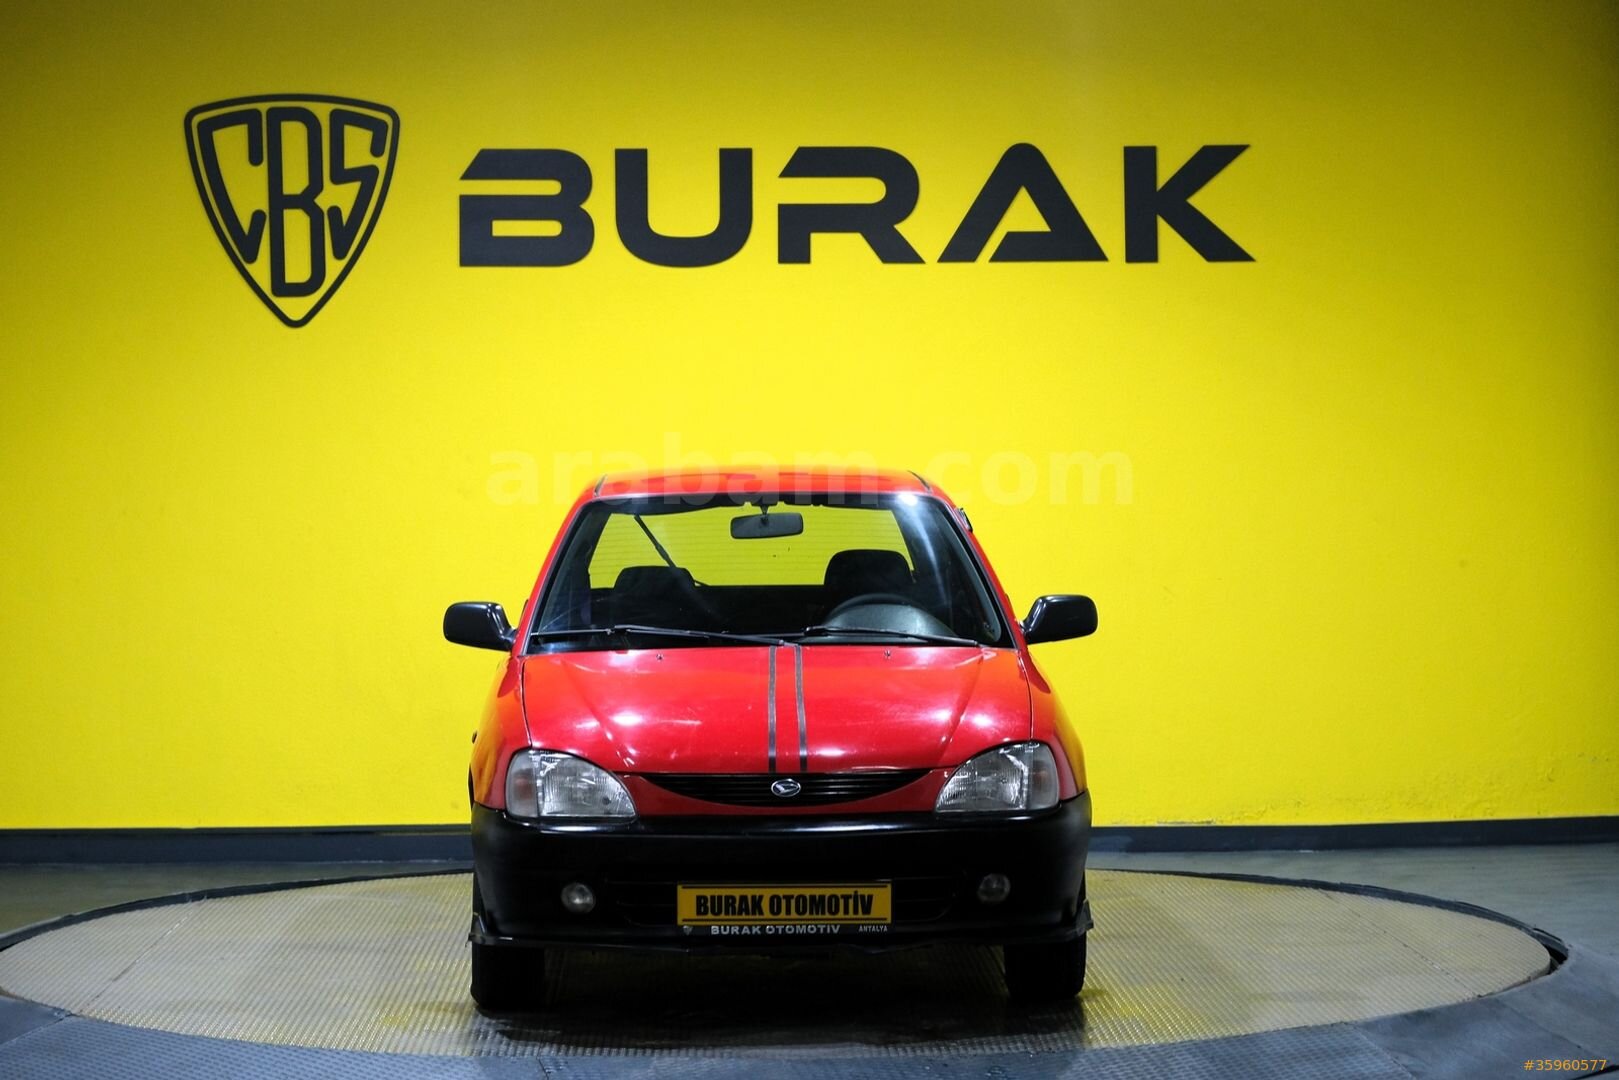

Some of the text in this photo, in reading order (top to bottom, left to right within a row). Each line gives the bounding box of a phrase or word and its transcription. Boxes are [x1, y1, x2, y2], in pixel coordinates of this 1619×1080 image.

[459, 142, 1256, 269] BURAK
[696, 890, 874, 916] BURAK OTOMOTİV
[711, 926, 761, 935] BURAK
